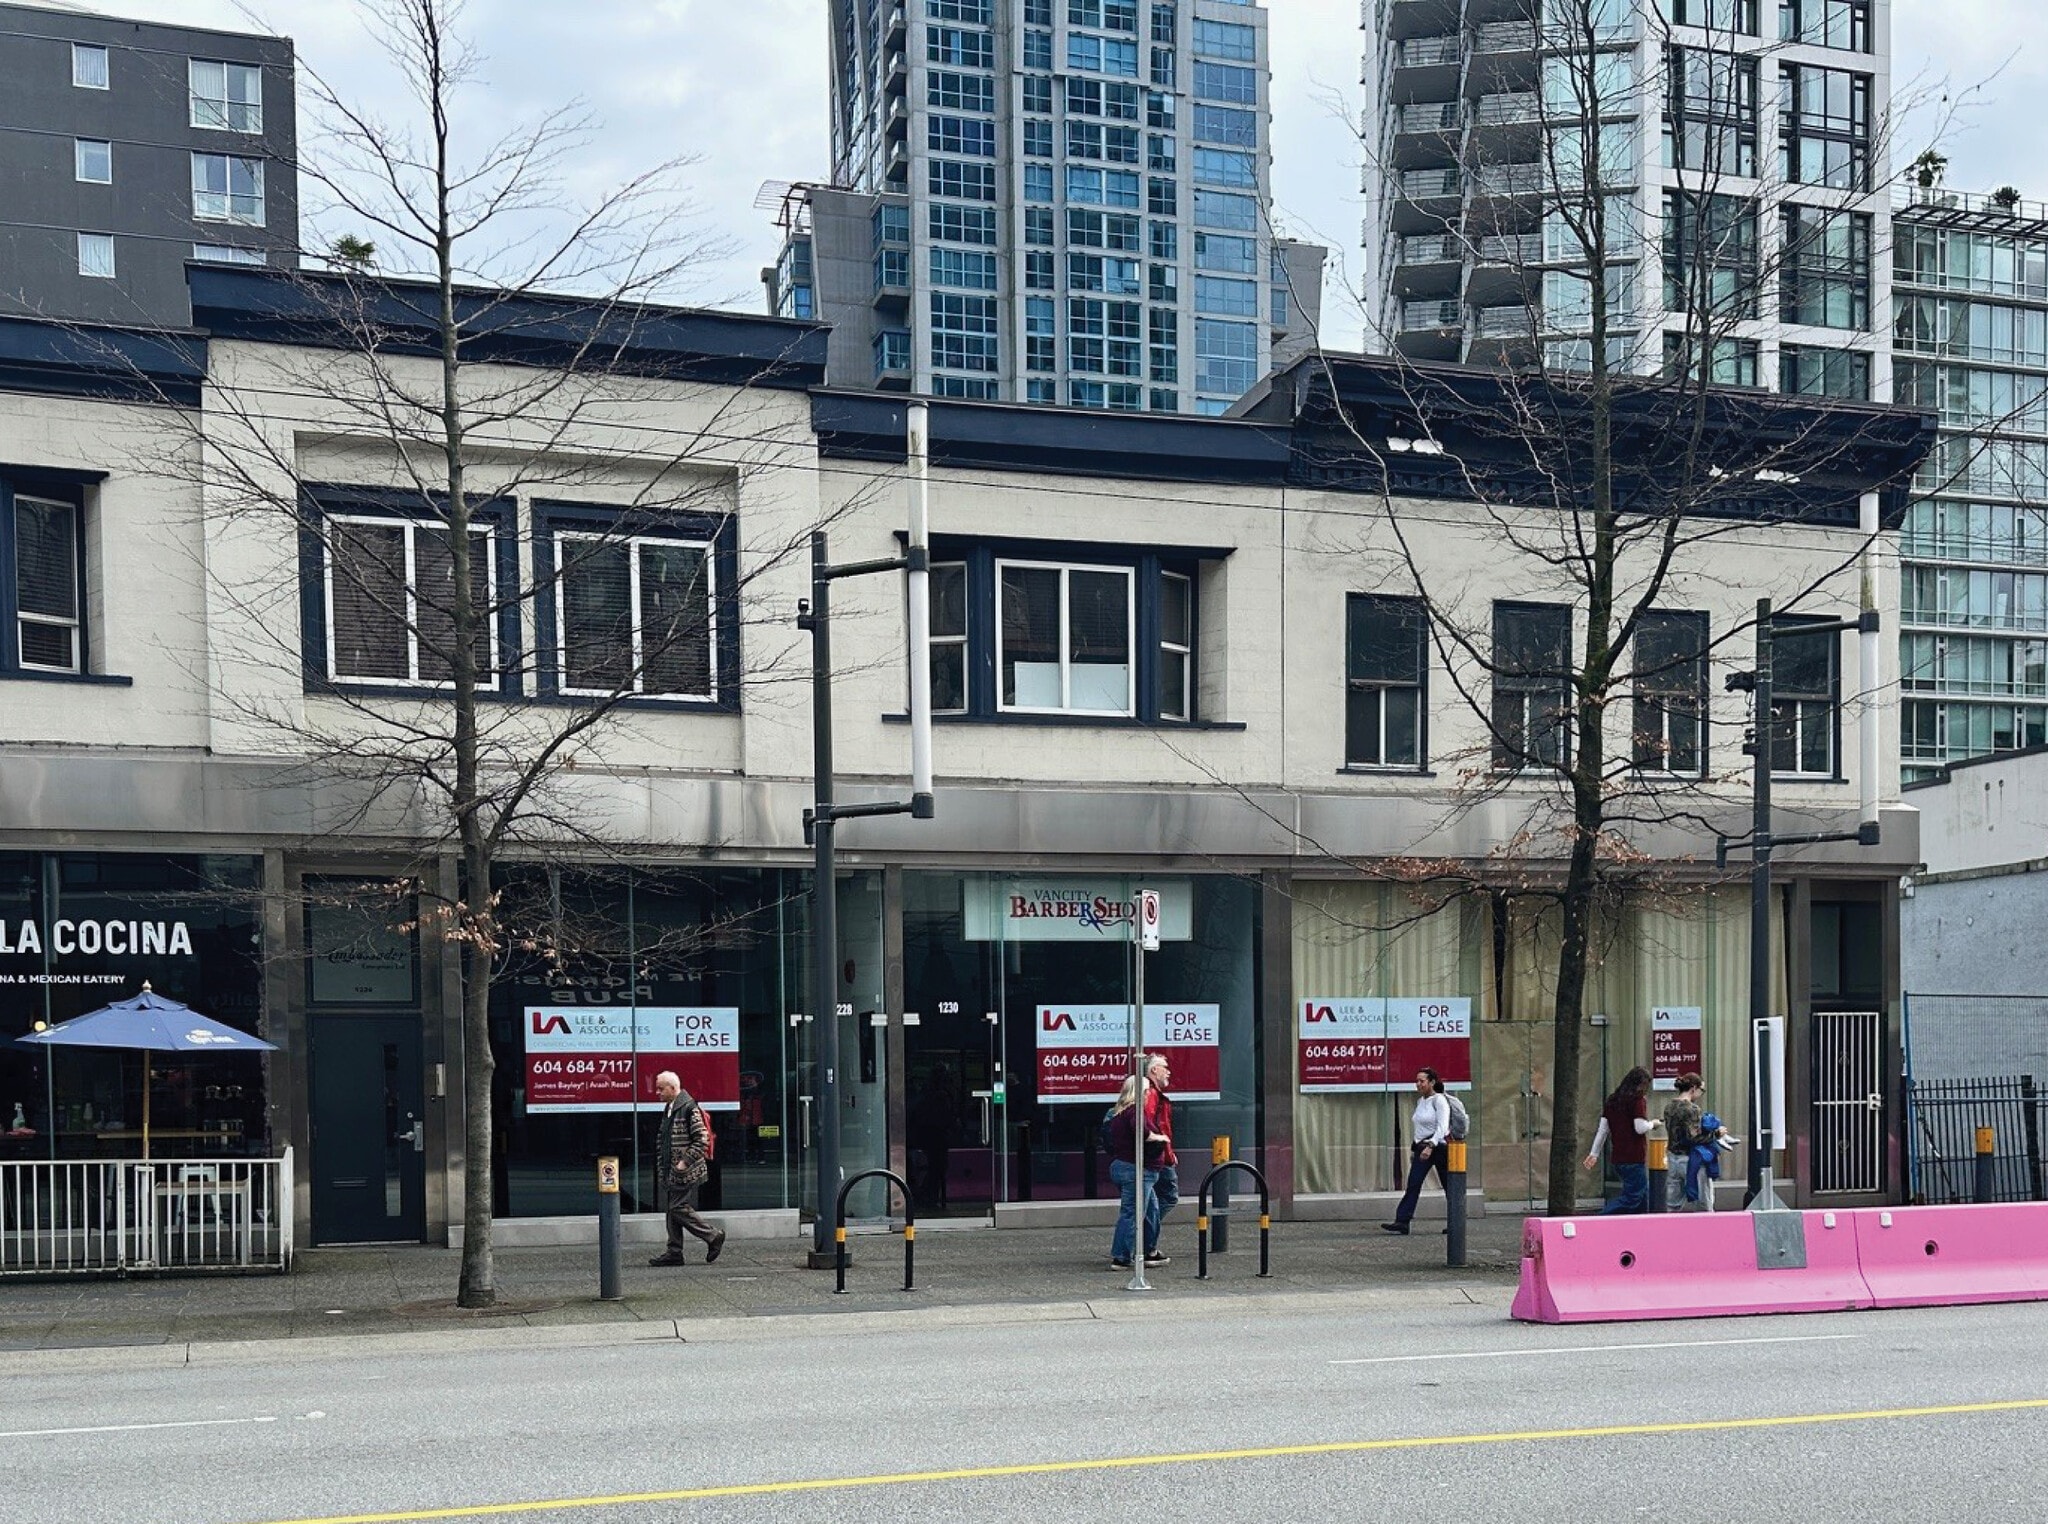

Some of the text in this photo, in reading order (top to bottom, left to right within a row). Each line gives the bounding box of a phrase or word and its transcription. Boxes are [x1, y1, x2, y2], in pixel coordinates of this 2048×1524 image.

[1034, 890, 1092, 900] VANCITY
[0, 919, 193, 955] LA COCINA
[17, 975, 26, 984] &
[29, 975, 81, 984] MEXICAN
[83, 975, 125, 984] EATERY
[938, 1002, 959, 1013] 1230
[1339, 1006, 1356, 1014] LEE
[1419, 1005, 1450, 1018] FOR
[575, 1016, 606, 1025] LEE &
[675, 1015, 712, 1029] FOR
[1079, 1013, 1106, 1021] LEE &
[1165, 1012, 1196, 1025] FOR
[1419, 1020, 1464, 1033] LEASE
[676, 1033, 730, 1047] LEASE
[1165, 1028, 1212, 1041] LEASE
[1655, 1033, 1673, 1041] FOR
[1305, 1045, 1385, 1057] 604 684 7117
[1655, 1042, 1681, 1050] LEASE
[1043, 1054, 1128, 1067] 604 684 7117
[533, 1060, 632, 1074] 604 684 7117
[534, 1081, 556, 1089] James
